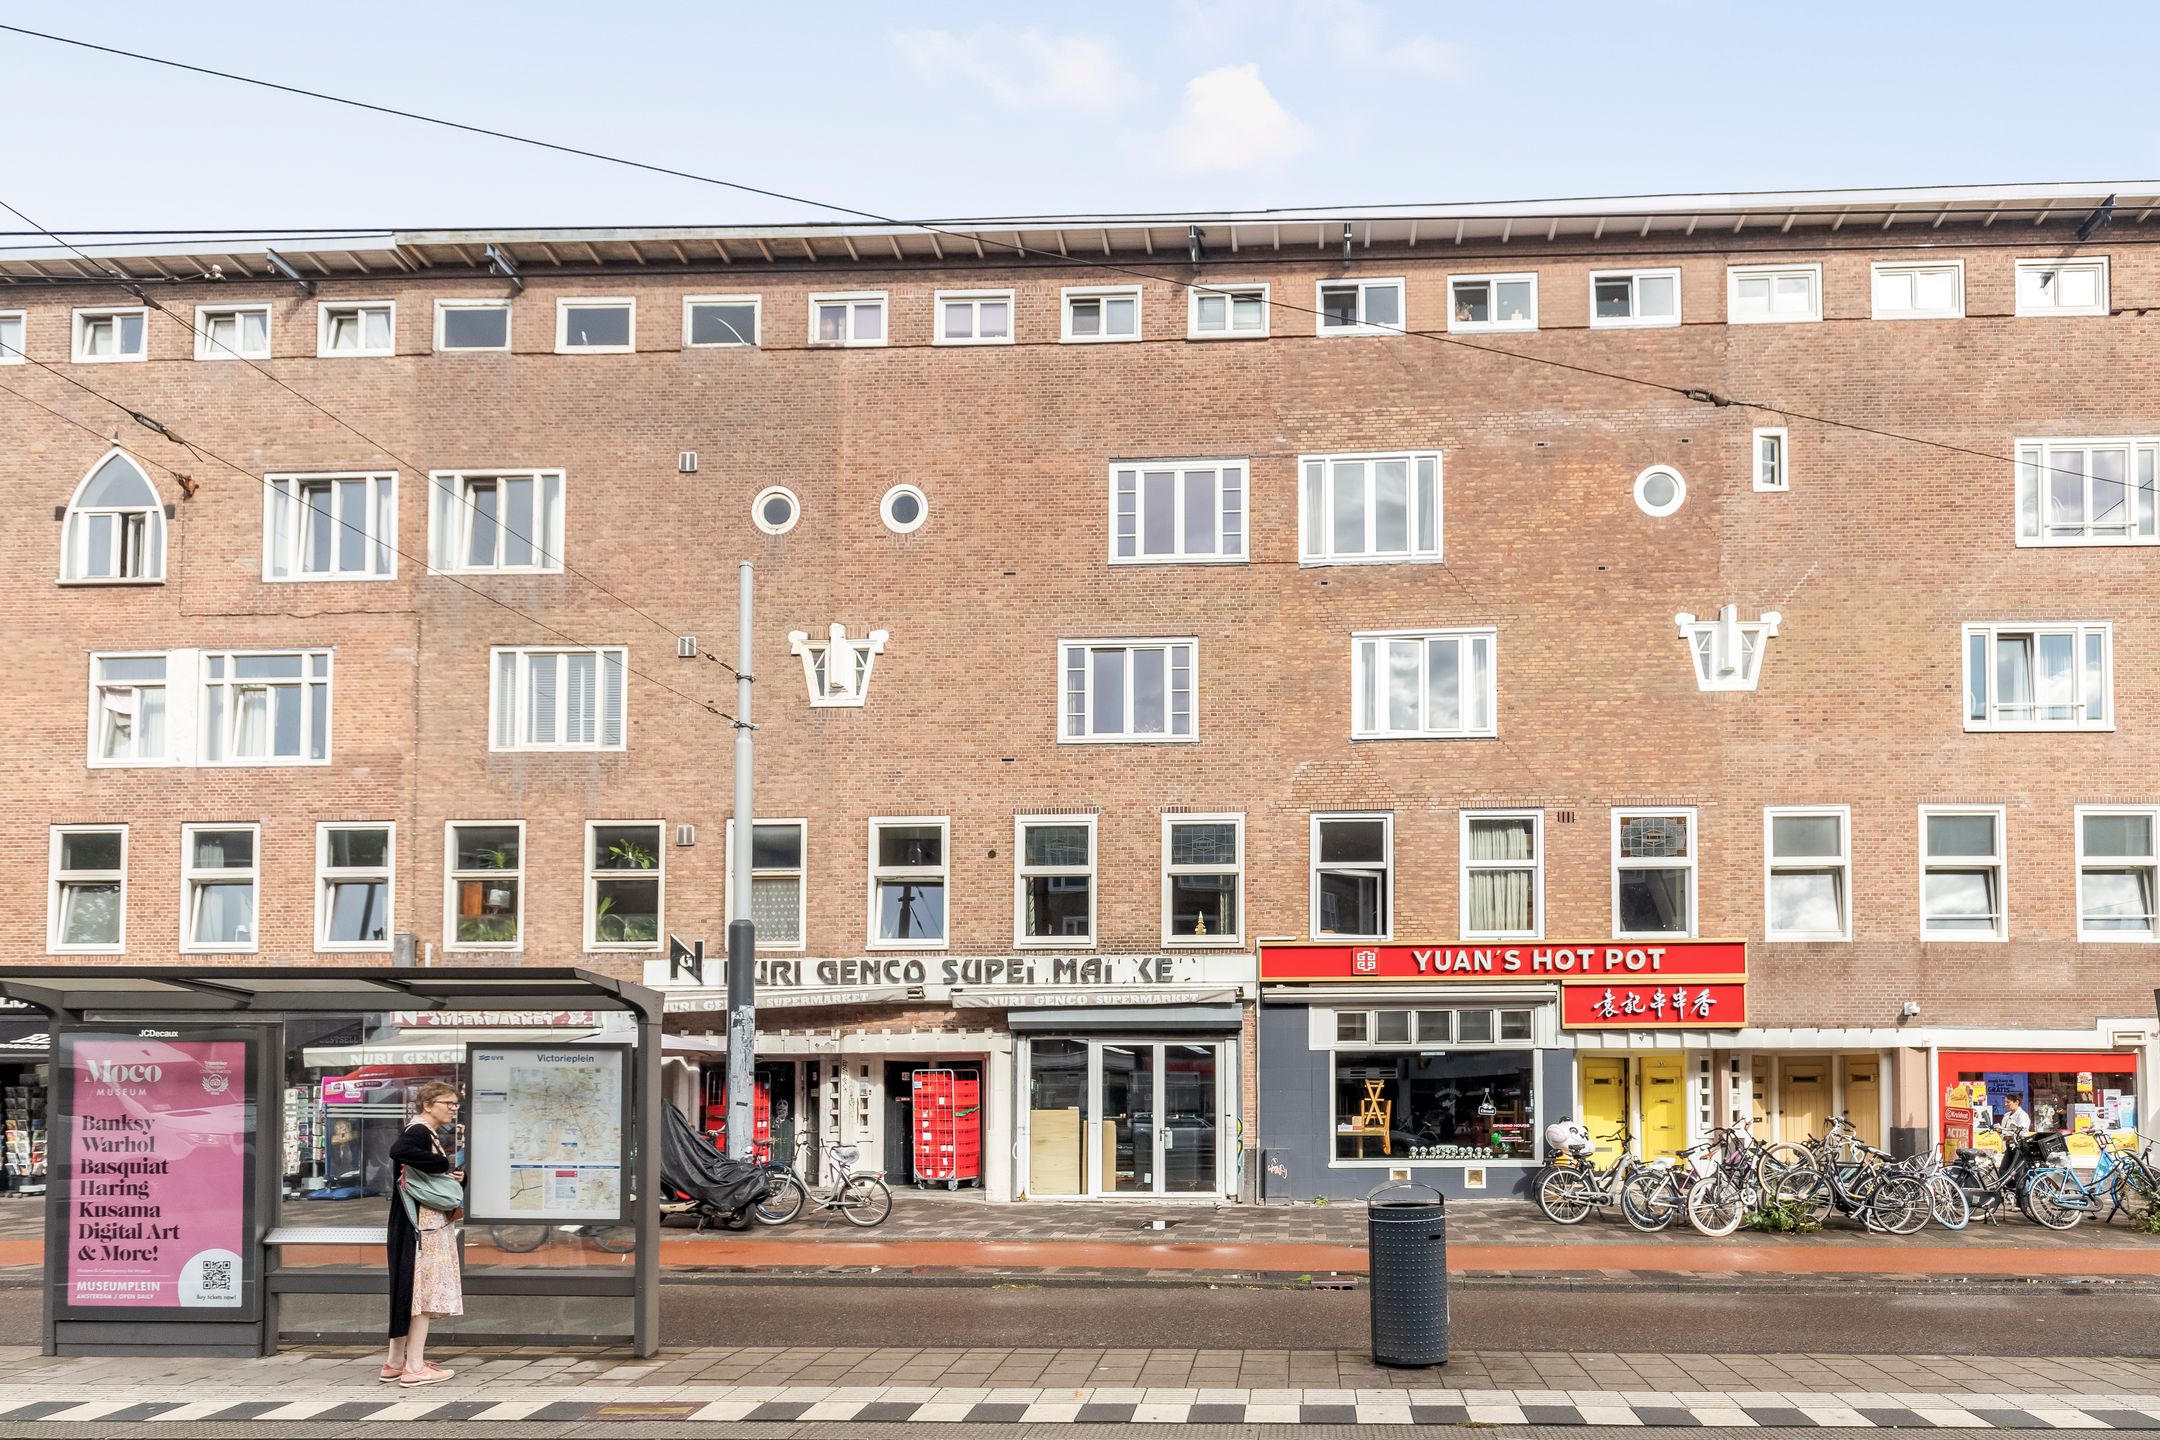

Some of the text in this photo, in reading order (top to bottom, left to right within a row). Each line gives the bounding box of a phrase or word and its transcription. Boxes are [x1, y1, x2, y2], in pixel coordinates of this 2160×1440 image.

[1413, 948, 1666, 971] YUAN'S HOT POT
[817, 959, 926, 985] GENCO
[767, 992, 869, 1007] SUPERMARKET
[988, 993, 1199, 1006] NURI GENCO SUPERMARKET
[138, 1029, 178, 1038] JCDecaux
[349, 1051, 464, 1066] NURI GENCO
[536, 1054, 595, 1063] Victorieplein
[84, 1059, 163, 1083] Moco
[96, 1088, 147, 1097] MUSEUM
[82, 1115, 156, 1135] Banksy
[82, 1136, 155, 1153] Warhol
[80, 1157, 169, 1178] Basquiat
[80, 1179, 150, 1200] Haring
[79, 1202, 161, 1218] Kusama
[79, 1222, 180, 1243] Digital Art
[78, 1245, 158, 1261] & More!
[76, 1281, 160, 1291] MUSEUMPLEIN
